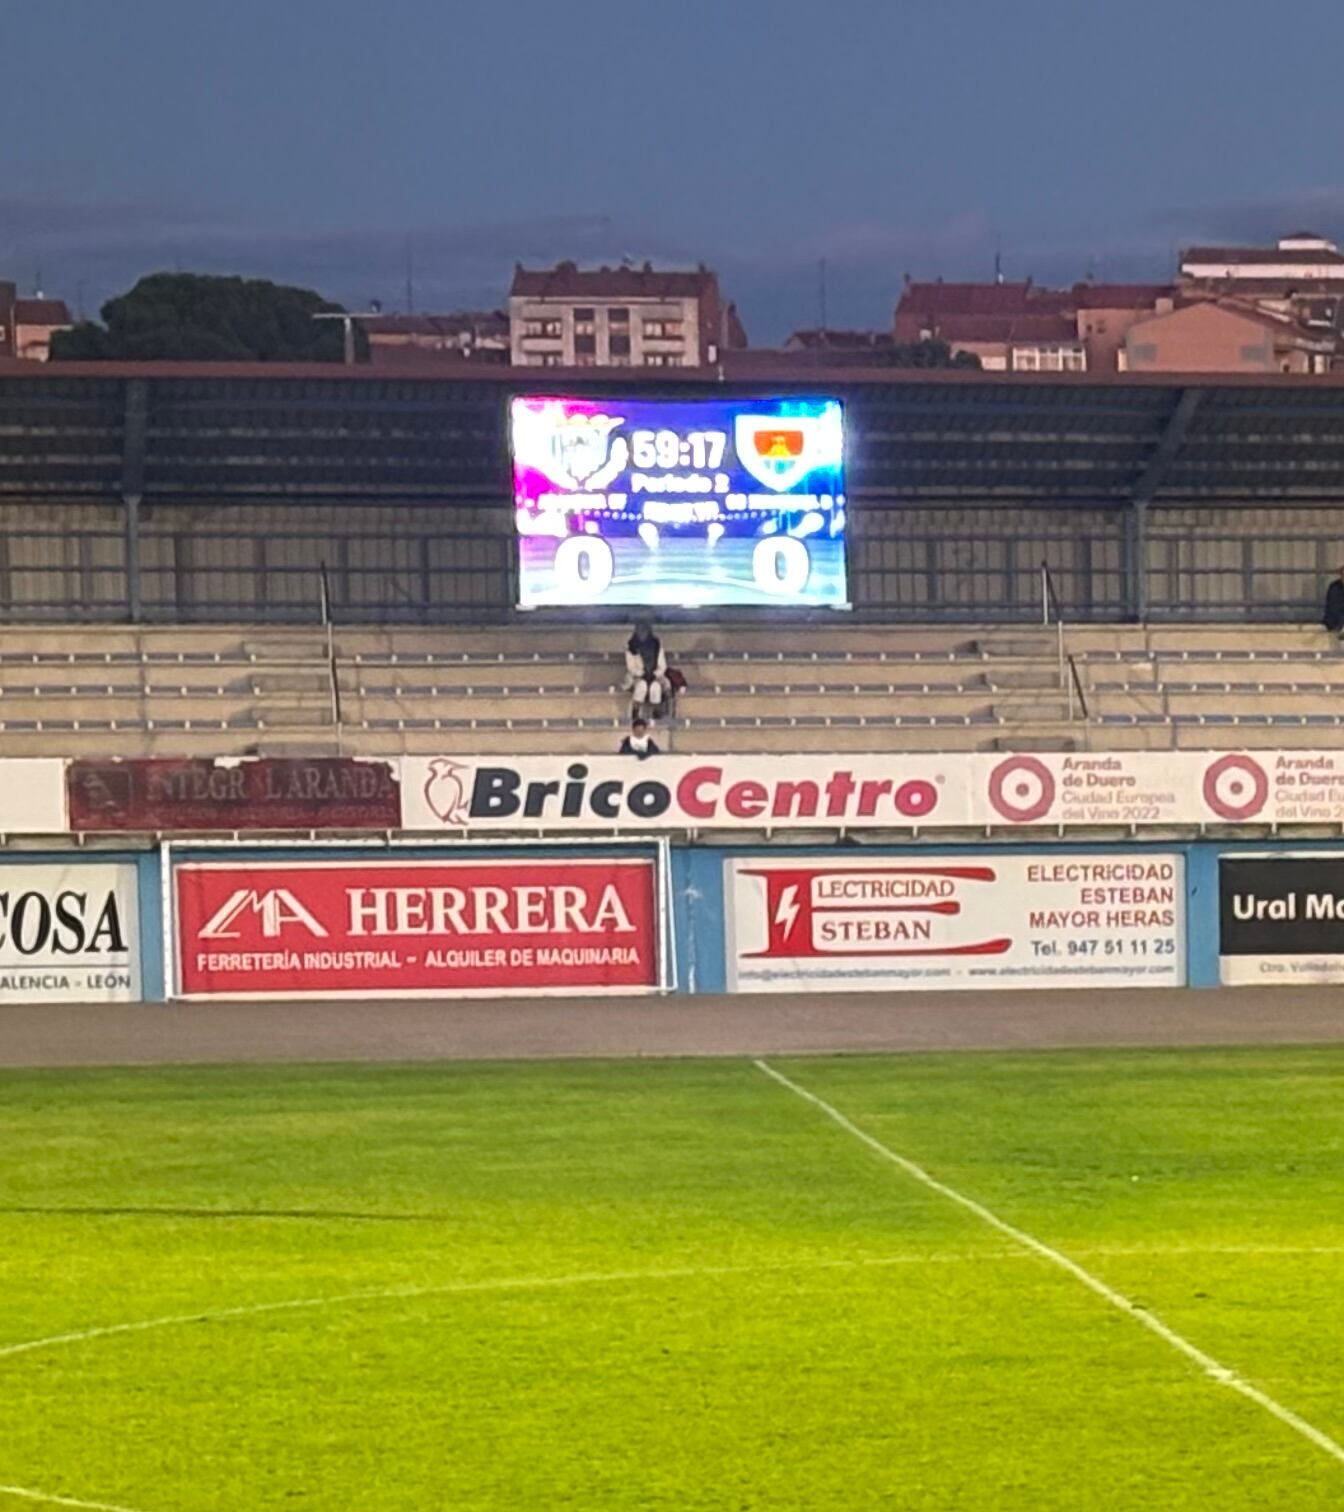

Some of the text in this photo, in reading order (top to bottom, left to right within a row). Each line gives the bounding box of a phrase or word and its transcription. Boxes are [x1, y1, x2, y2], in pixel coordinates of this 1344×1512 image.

[555, 535, 613, 592] 0
[753, 536, 810, 592] 0
[1062, 757, 1122, 771] Aranda
[1276, 756, 1335, 770] Aranda
[148, 767, 281, 800] INTEGRL
[1063, 773, 1136, 787] de Duero
[1276, 772, 1296, 786] de
[469, 763, 937, 818] BricoCentro
[1062, 790, 1175, 805] Ciudad Europea
[1275, 789, 1325, 803] Ciudad
[1062, 805, 1160, 819] del Vino 2022
[1301, 804, 1331, 818] Vino
[1027, 864, 1173, 882] ELECTRICIDAD
[1081, 888, 1174, 905] ESTEBAN
[346, 884, 637, 936] HERRERA
[1233, 893, 1296, 919] Ural
[0, 890, 129, 955] OSA
[1029, 910, 1175, 928] MAYOR HERAS
[1032, 939, 1175, 956] Tel. 947 51 11 25
[197, 947, 640, 972] FERRETERÍA INDUSTRIAL ALQUILER DE MAQUINARIA
[87, 974, 131, 989] LEÓN
